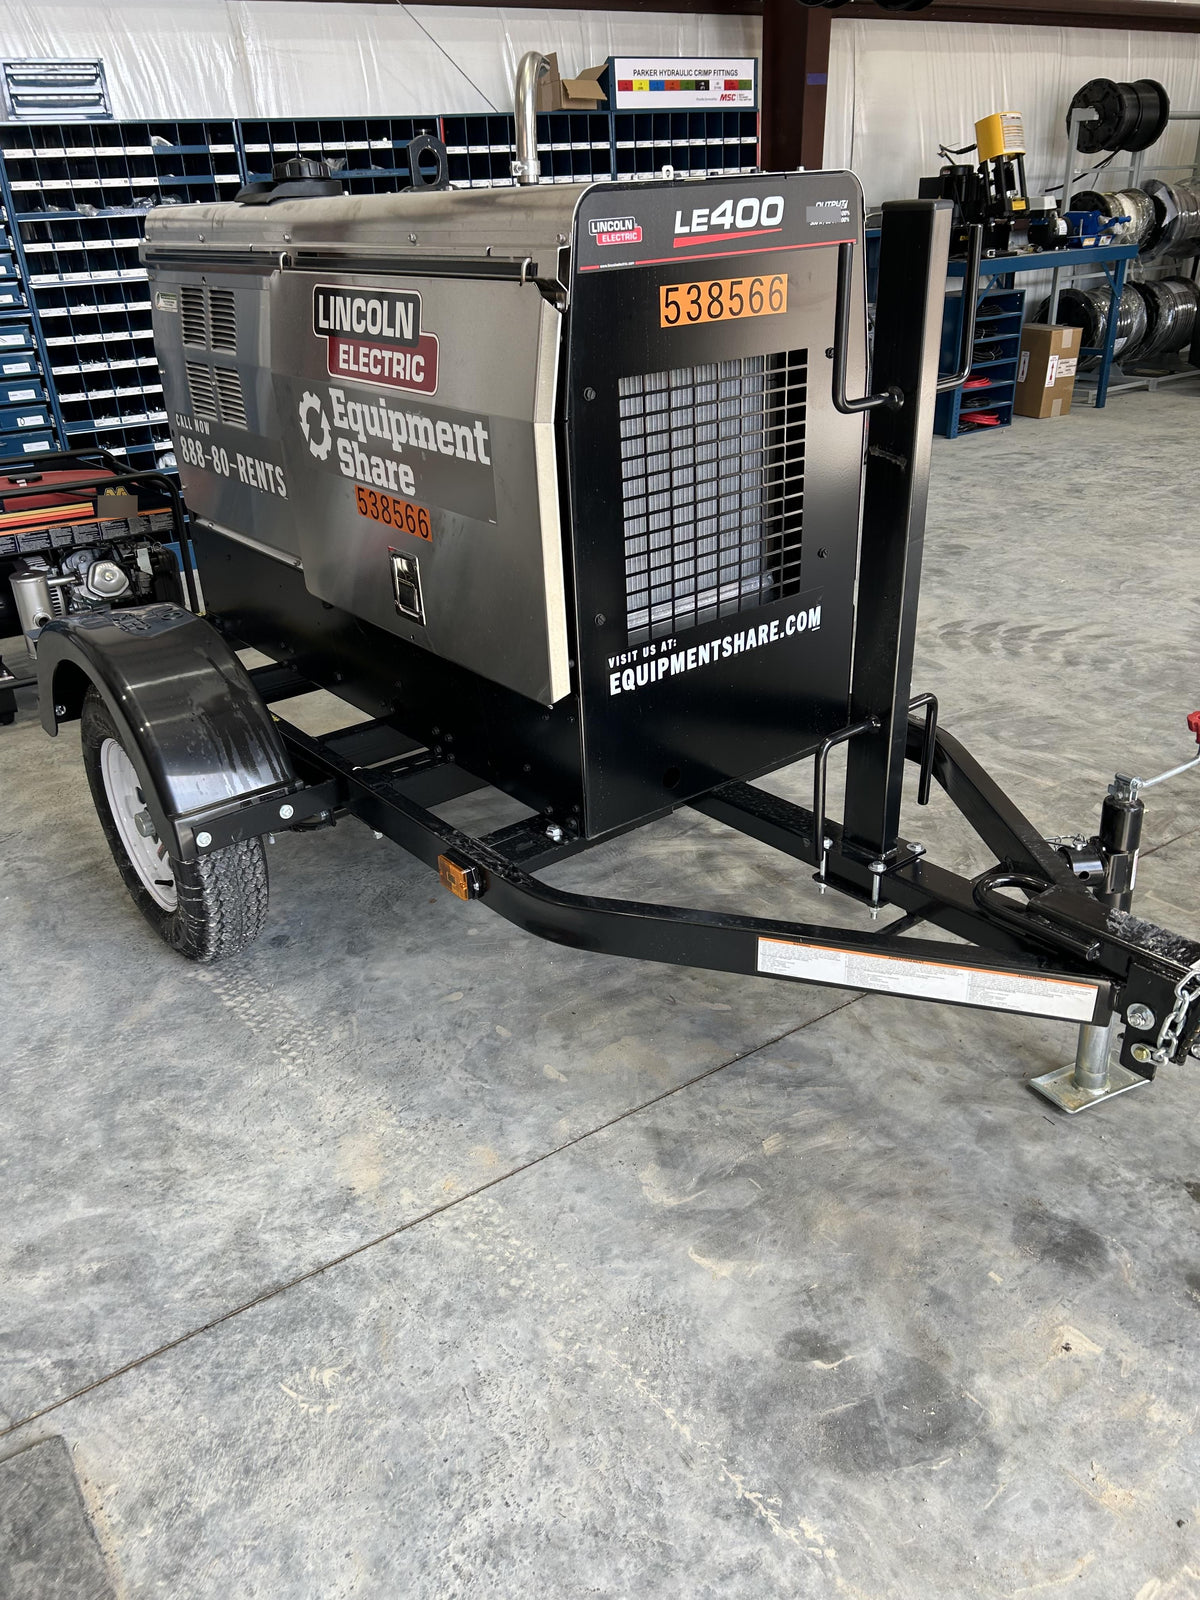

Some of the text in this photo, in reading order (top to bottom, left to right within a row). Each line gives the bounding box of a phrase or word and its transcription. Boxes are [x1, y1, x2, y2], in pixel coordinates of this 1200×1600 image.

[633, 69, 739, 77] PARKER HYDRAULIC CRIMP FITTINGS
[720, 93, 737, 101] MSC
[591, 219, 633, 233] LINCOLN
[674, 195, 785, 234] LE400
[602, 232, 638, 243] ELECTRIC
[318, 294, 414, 340] LINCOLN
[664, 276, 784, 324] 538566
[338, 343, 425, 383] ELECTRIC
[175, 413, 210, 436] CALL NOW
[328, 387, 491, 466] Equipment
[179, 435, 288, 499] 888-80-RENTS
[336, 437, 416, 496] Share
[357, 486, 429, 539] 538566
[608, 638, 677, 669] VISIT US AT:
[610, 605, 822, 696] EQUIPMENTSHARE.COM
